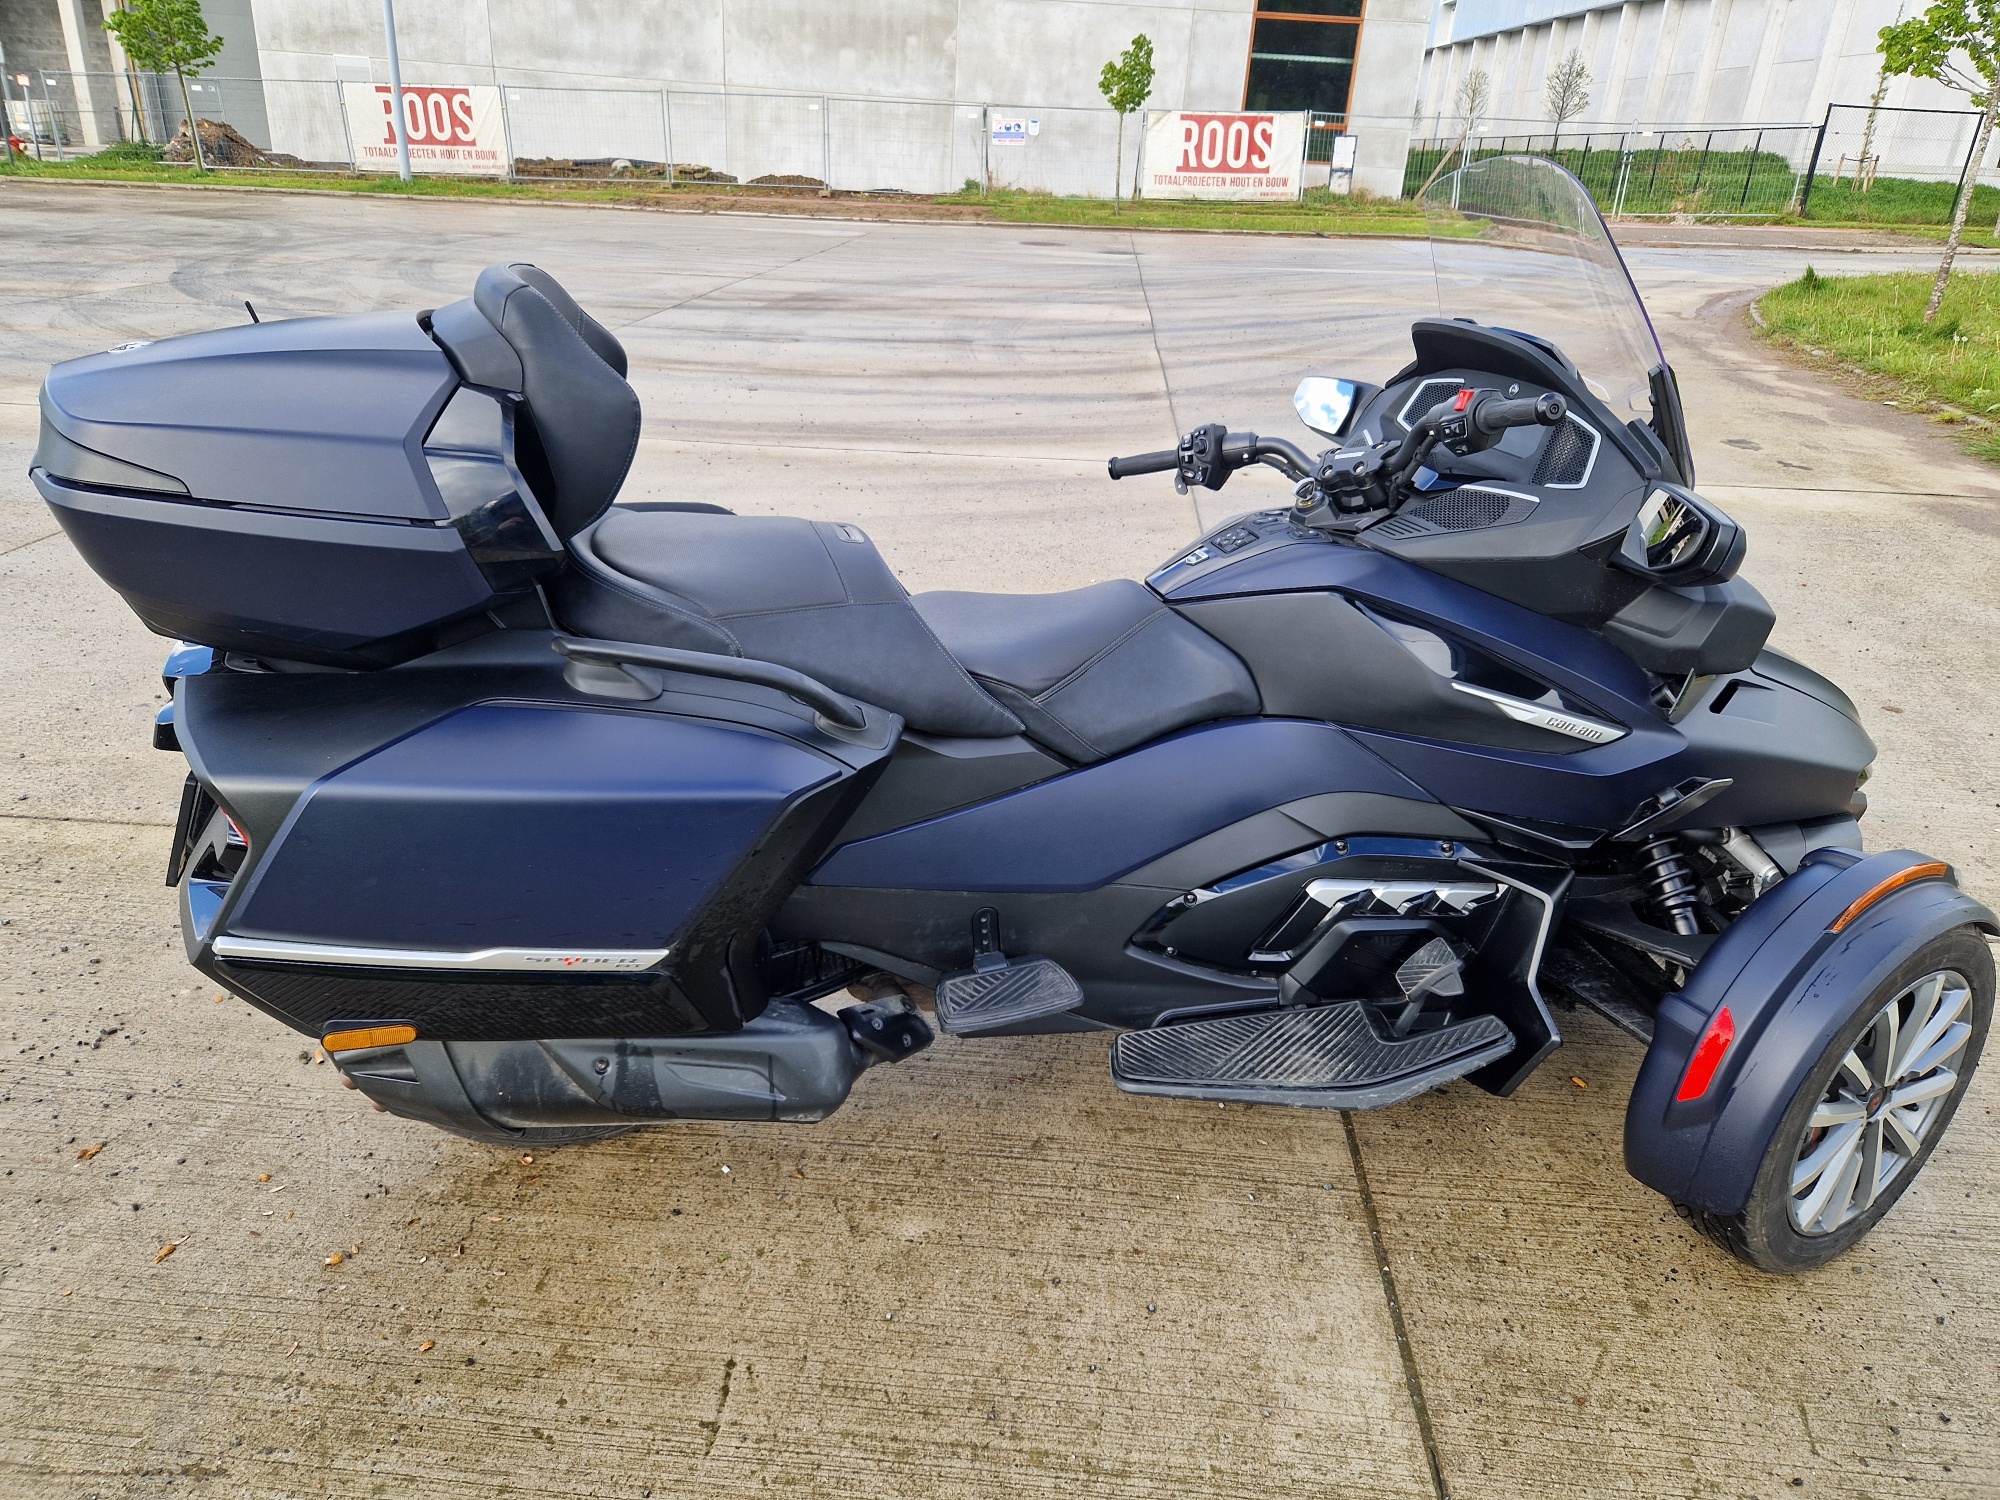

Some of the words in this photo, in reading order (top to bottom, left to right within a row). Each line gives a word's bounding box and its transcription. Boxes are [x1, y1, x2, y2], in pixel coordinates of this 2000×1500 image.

[1177, 118, 1273, 169] ROOS
[439, 148, 460, 161] HOUT
[462, 150, 474, 161] EN
[475, 151, 498, 161] BOUW
[1153, 174, 1227, 188] TOTAALPROJECTEN
[1229, 177, 1251, 188] HOUT
[1253, 177, 1263, 188] EN
[1265, 177, 1289, 189] BOUW
[1544, 716, 1603, 739] can-am
